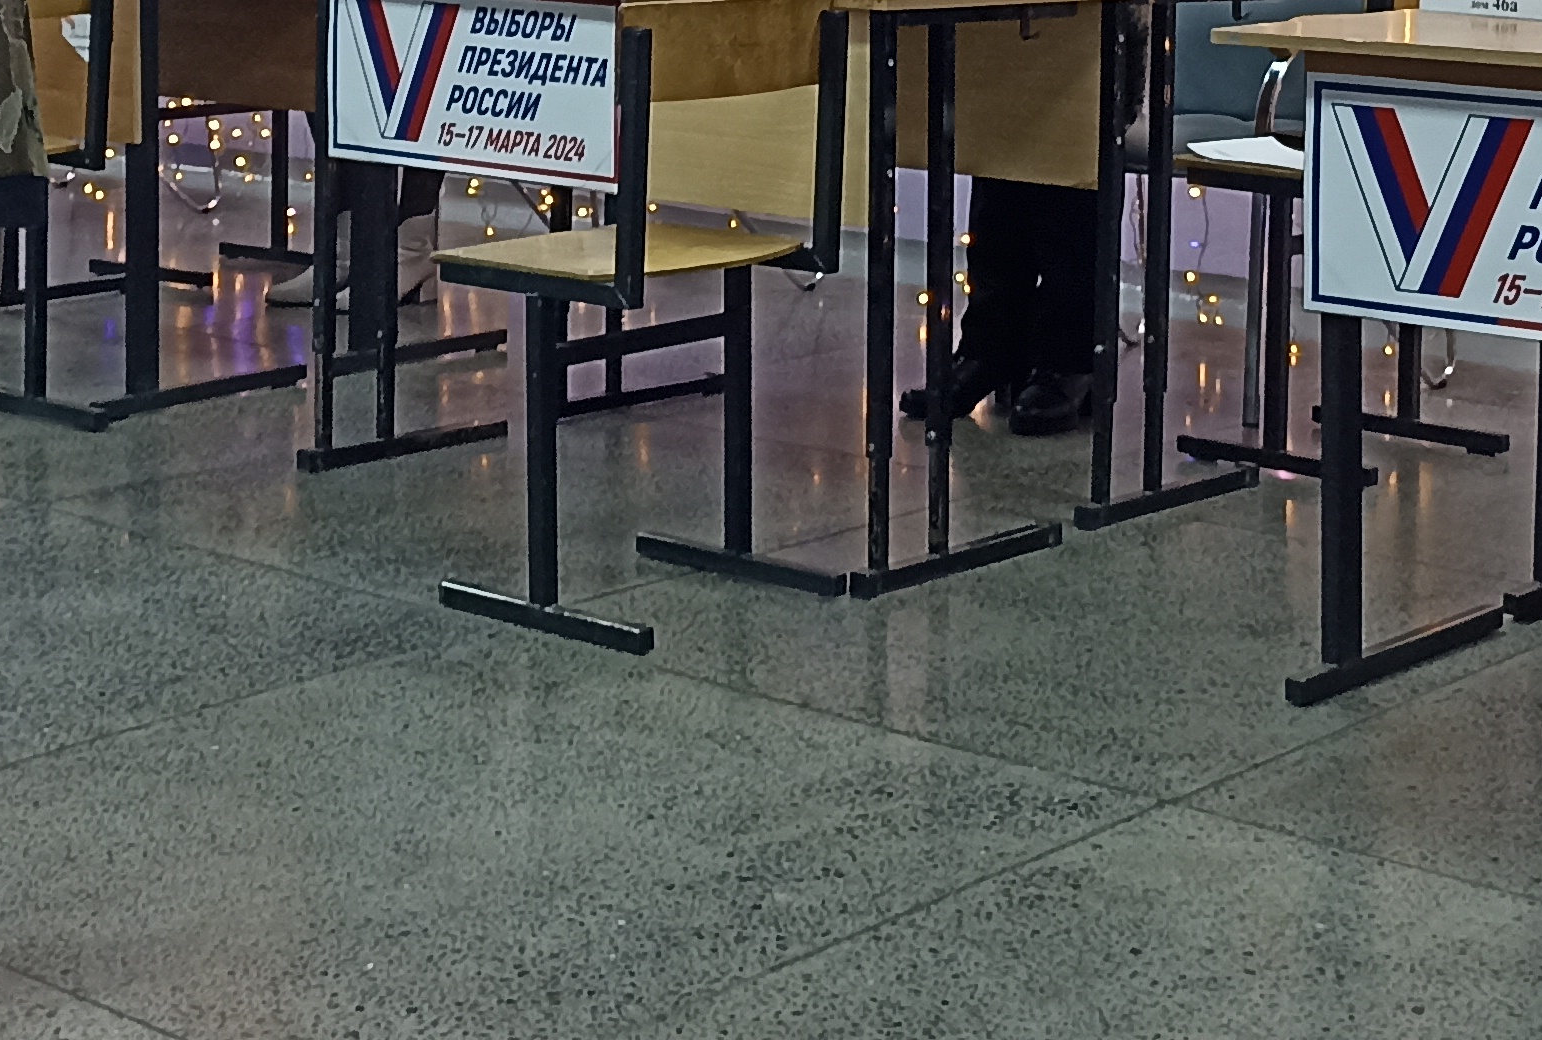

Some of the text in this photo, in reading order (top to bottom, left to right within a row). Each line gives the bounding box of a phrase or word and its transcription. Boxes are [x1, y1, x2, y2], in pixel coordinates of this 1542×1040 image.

[469, 6, 578, 43] ВЫБОРЫ
[458, 45, 609, 88] ПРЕЗИДЕНТА
[446, 84, 542, 121] РОССИИ
[483, 127, 542, 154] МАРТА
[543, 133, 586, 162] 2024
